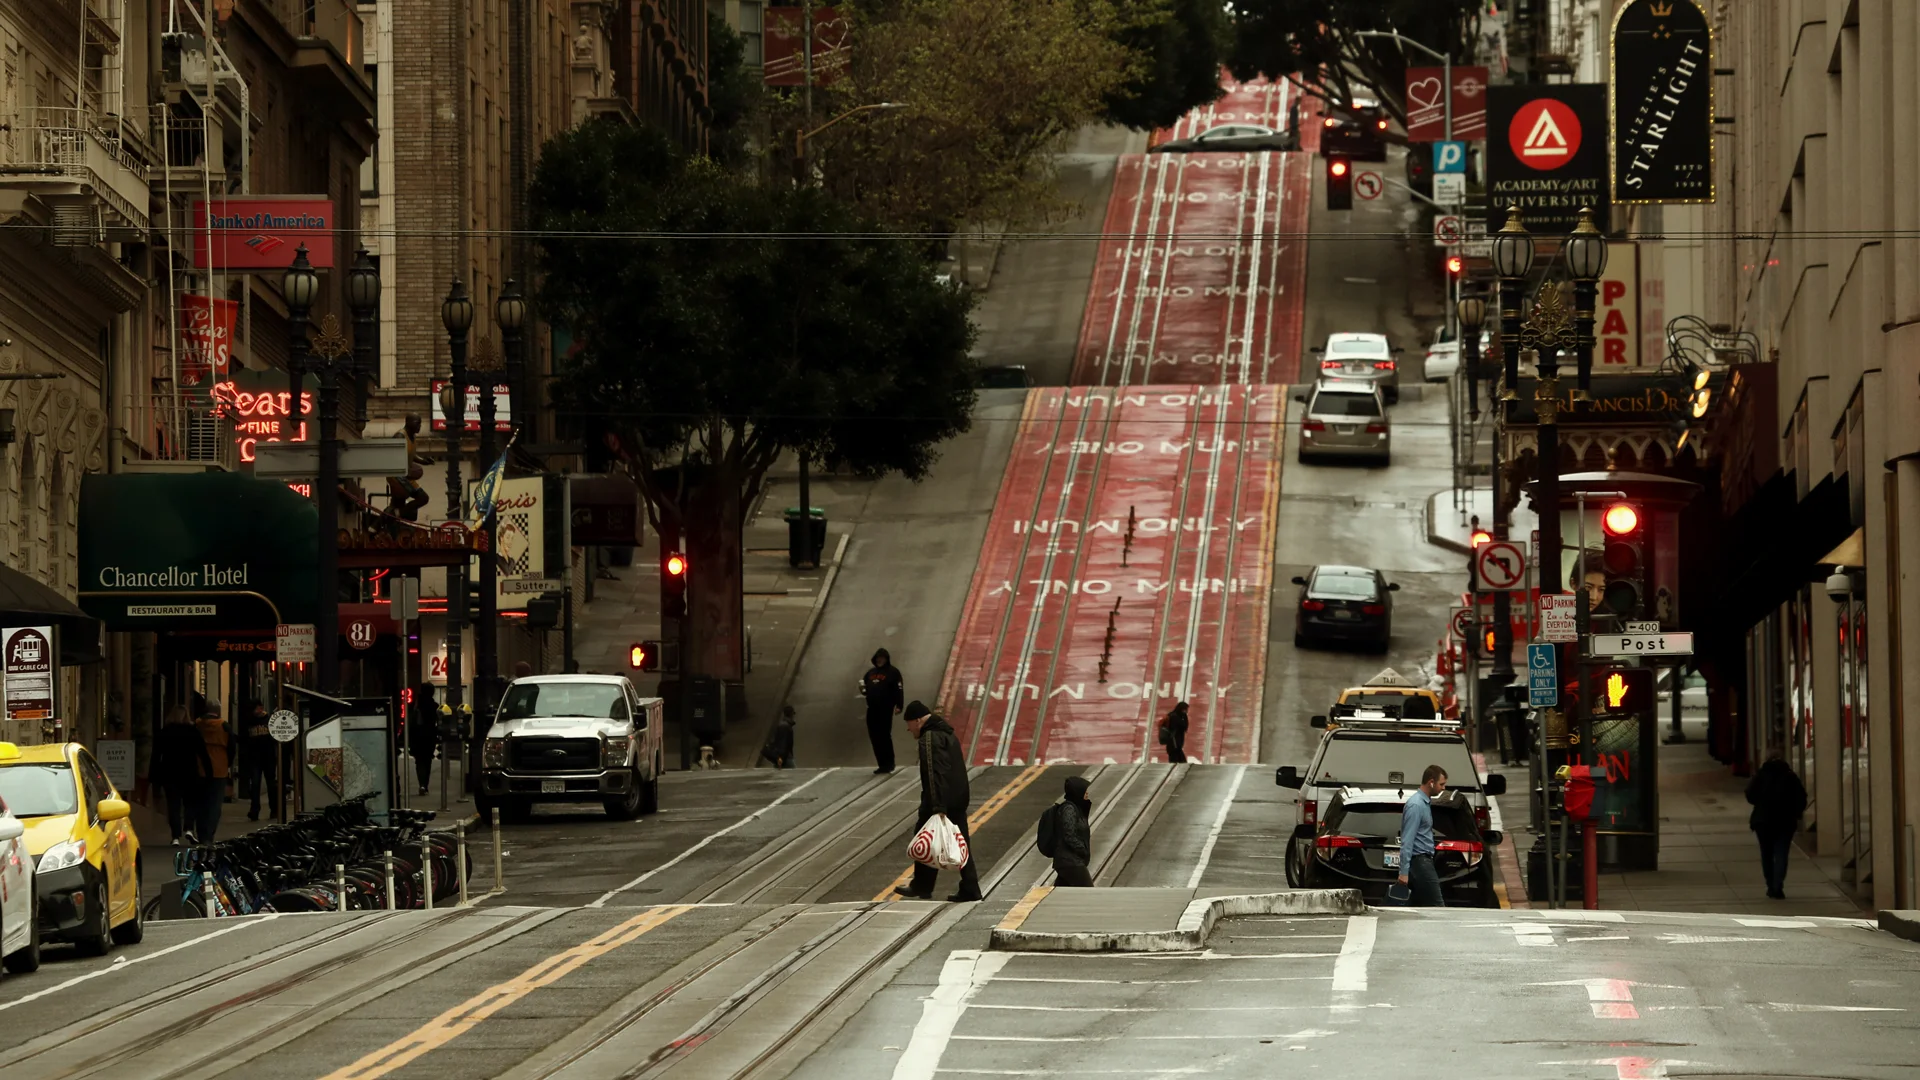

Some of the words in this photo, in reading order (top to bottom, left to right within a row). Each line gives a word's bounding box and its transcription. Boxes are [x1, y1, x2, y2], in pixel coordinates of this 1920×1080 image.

[1625, 66, 1667, 145] LIZZIE'S
[1624, 39, 1704, 190] STARLIGHT
[1493, 180, 1560, 192] ACADEMY
[1560, 182, 1573, 193] of
[1573, 179, 1599, 190] ART
[1492, 195, 1598, 207] UNIVERSITY
[209, 213, 246, 228] Bank
[246, 213, 263, 228] of
[263, 213, 325, 228] America
[182, 337, 228, 366] NAILS
[210, 381, 313, 417] Sears
[1049, 395, 1146, 408] MUNI
[1160, 393, 1266, 407] ONLY
[247, 421, 280, 434] FINE
[1159, 440, 1262, 454] MUNI
[495, 492, 538, 512] ori's
[1013, 519, 1120, 534] MUNI
[1138, 518, 1257, 532] ONLY
[99, 566, 198, 587] Chancellor
[203, 562, 249, 586] Hotel
[516, 582, 549, 590] Sutter
[988, 580, 1113, 596] ONLY
[1137, 580, 1249, 594] MUNI
[1542, 596, 1553, 609] NO
[131, 607, 186, 615] RESTAURANT
[195, 606, 212, 614] BAR
[277, 626, 289, 636] NO
[351, 622, 371, 641] 81
[1547, 620, 1574, 629] EVERYDAY
[1637, 623, 1659, 631] 400
[216, 640, 256, 652] Sears
[1621, 638, 1665, 650] Post
[1530, 668, 1555, 678] PARKING
[1107, 681, 1239, 699] ONLY
[1535, 678, 1551, 688] ONLY
[966, 682, 1085, 700] MUNI
